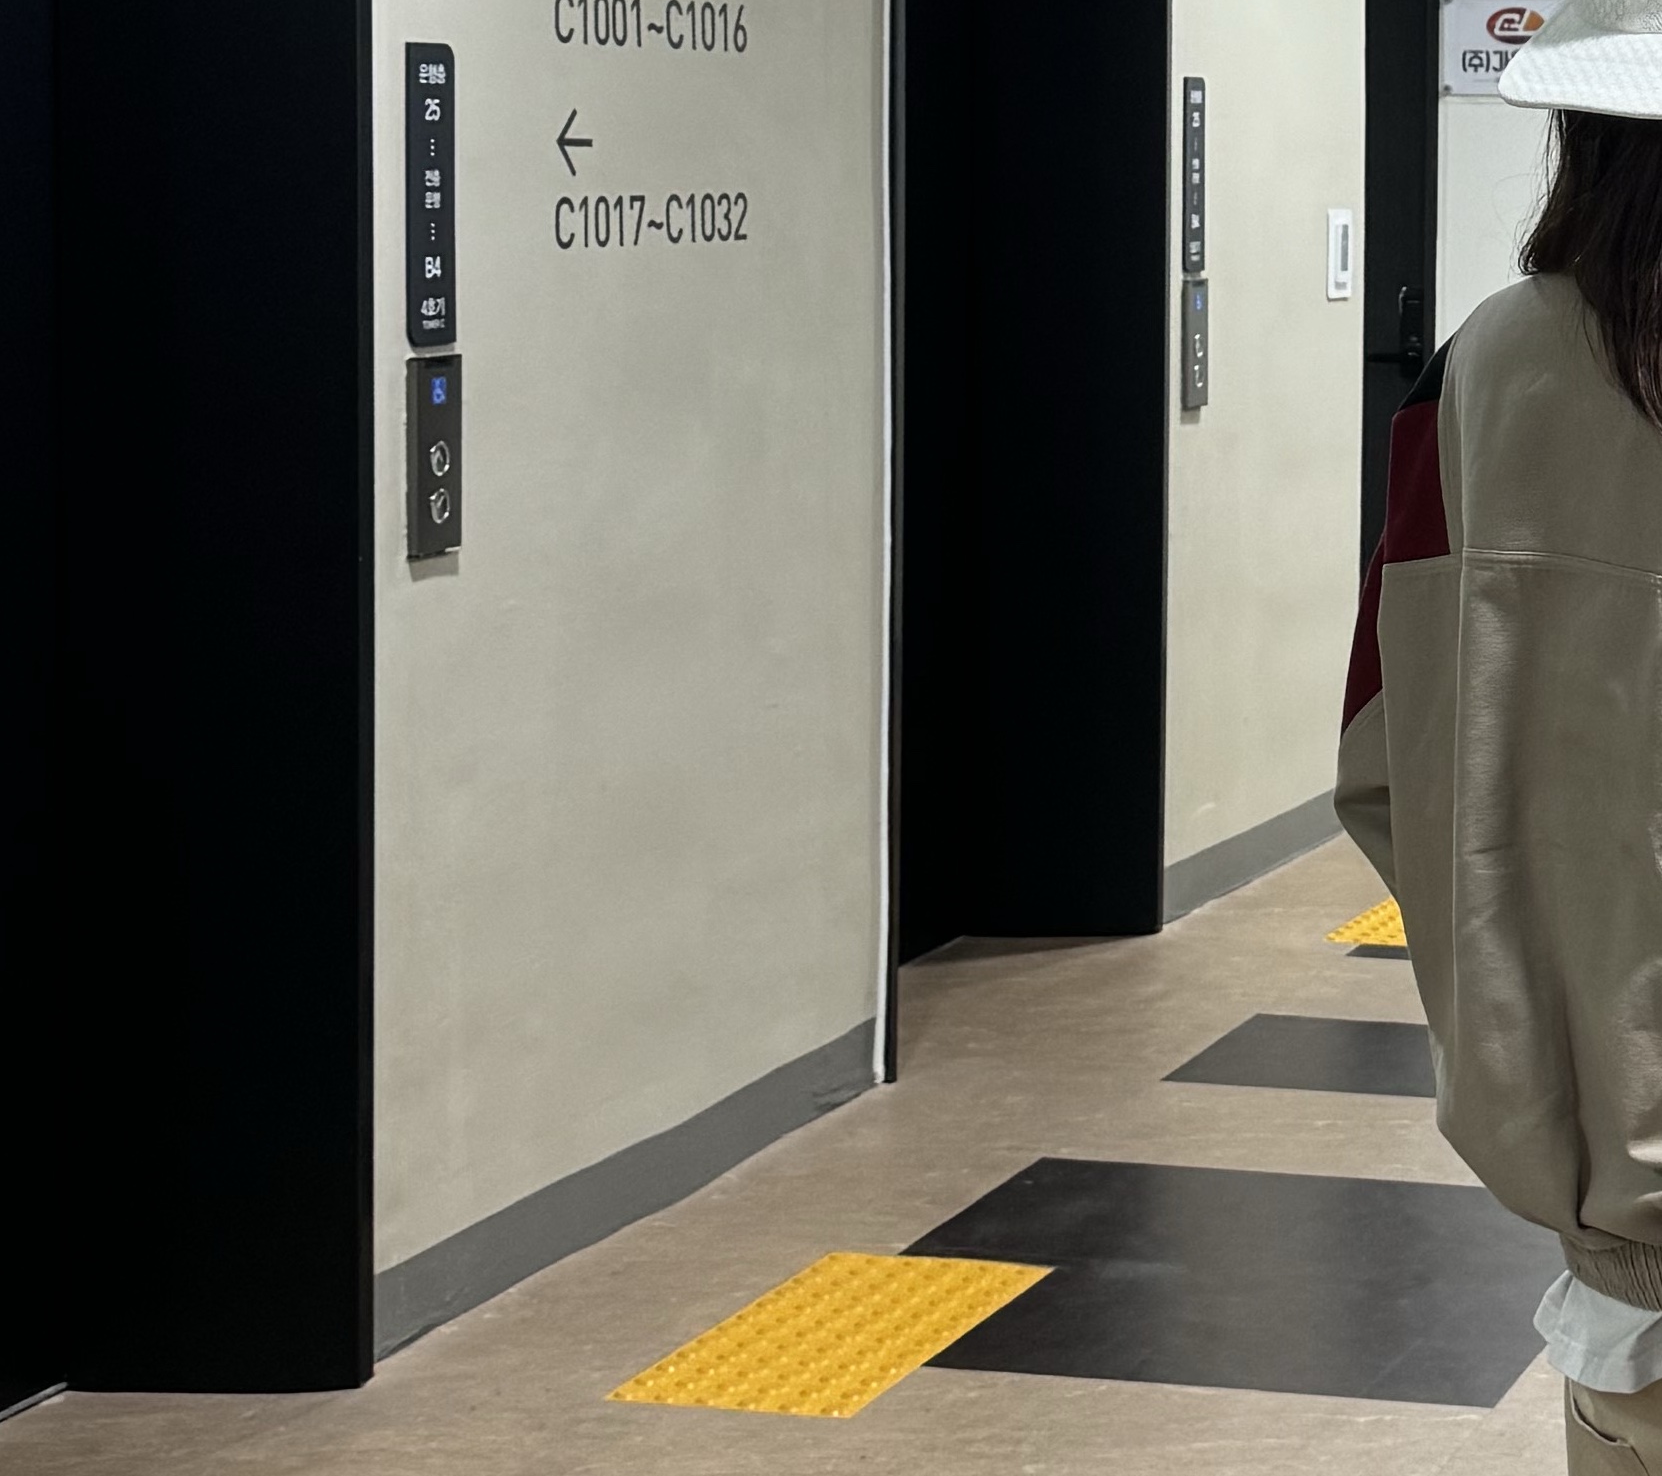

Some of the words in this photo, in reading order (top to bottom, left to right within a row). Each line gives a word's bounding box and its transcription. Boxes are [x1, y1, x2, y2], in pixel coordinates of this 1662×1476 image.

[424, 98, 441, 121] 25
[554, 192, 748, 250] C1017~C1032
[424, 255, 442, 279] B4
[420, 297, 446, 316] 4호기
